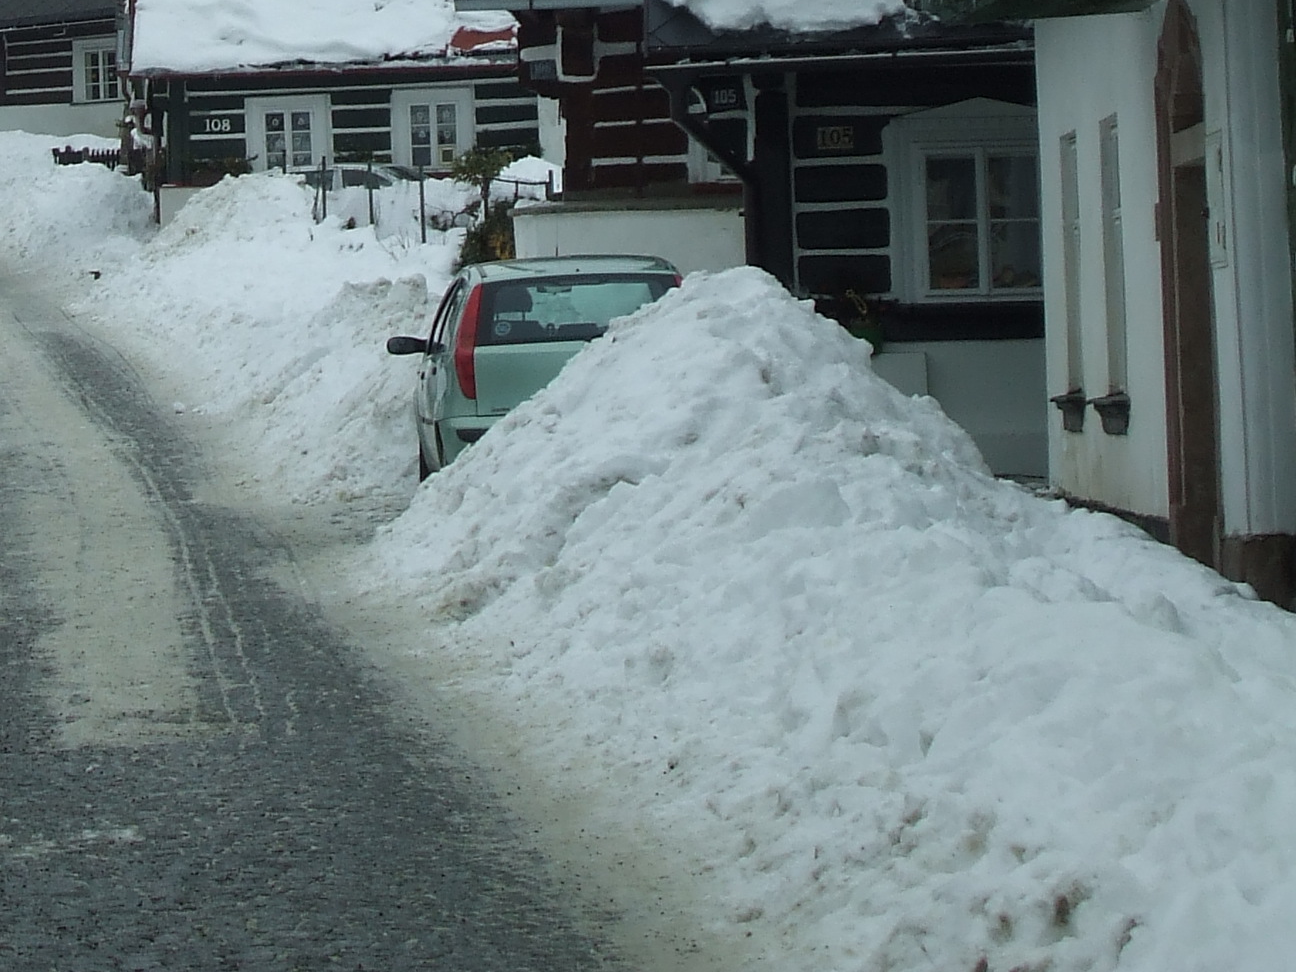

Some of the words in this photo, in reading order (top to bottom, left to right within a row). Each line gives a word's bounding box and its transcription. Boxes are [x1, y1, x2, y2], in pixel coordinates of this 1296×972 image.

[714, 89, 736, 104] 105
[205, 119, 231, 132] 108
[820, 128, 852, 147] 105
